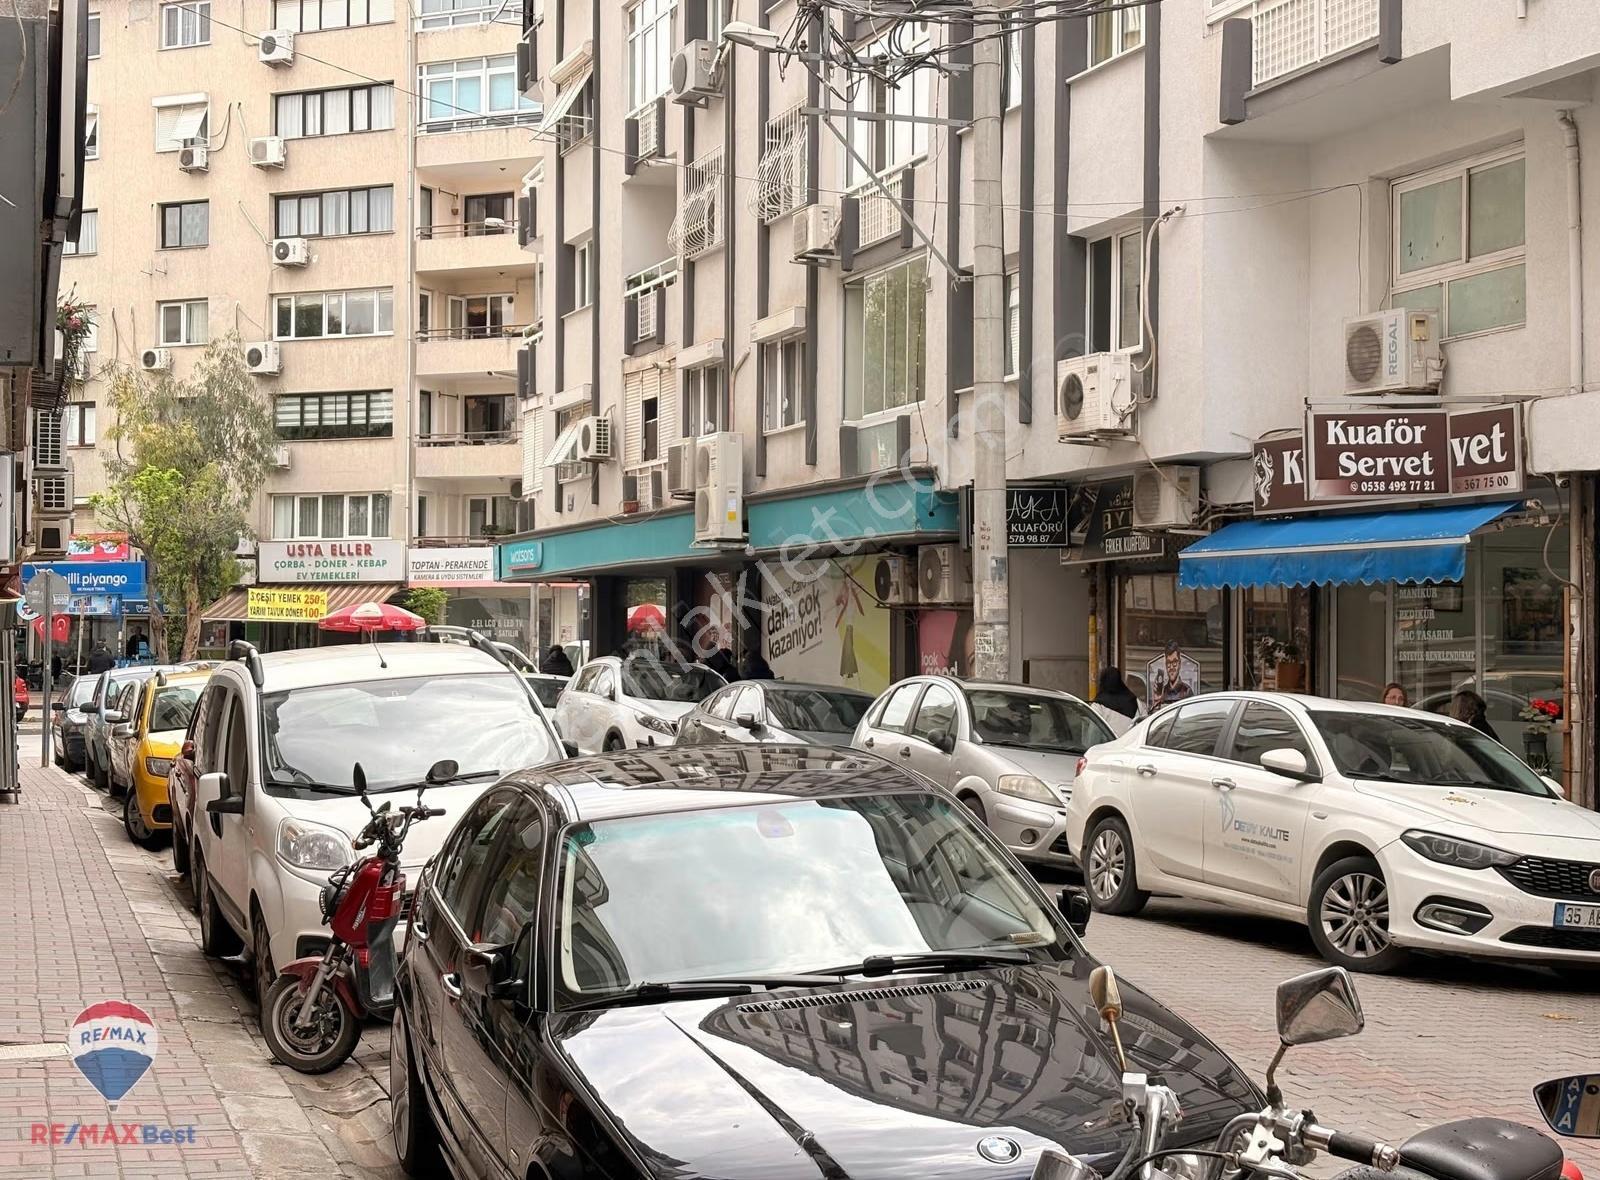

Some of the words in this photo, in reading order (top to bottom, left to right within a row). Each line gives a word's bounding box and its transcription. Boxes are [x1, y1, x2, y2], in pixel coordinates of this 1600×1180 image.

[1388, 317, 1398, 376] REGAL
[1325, 417, 1427, 446] Kuaför
[1338, 450, 1435, 477] Servet
[1361, 481, 1386, 491] 0538
[1389, 481, 1407, 491] 492
[1409, 481, 1420, 491] 77
[1424, 480, 1435, 491] 21
[1483, 476, 1495, 488] 75
[1497, 475, 1509, 487] 00
[1011, 521, 1063, 533] KUAFÖRÜ
[1009, 534, 1025, 543] 578
[1026, 534, 1038, 543] 98
[1039, 534, 1050, 543] 87
[1105, 537, 1123, 554] ERKEK
[287, 544, 324, 557] USTA
[331, 543, 373, 556] ELLER
[274, 560, 305, 571] ÇORBA
[314, 557, 348, 569] DÖNER
[357, 559, 388, 568] KEBAP
[411, 561, 440, 570] TOPTAN
[444, 560, 489, 569] PERAKENDE
[64, 572, 80, 585] illi
[82, 572, 128, 587] piyango
[296, 572, 308, 580] EV
[310, 569, 360, 580] YEMEKLERİ
[250, 592, 255, 601] 3
[256, 591, 276, 604] ÇEŞİT
[278, 593, 302, 603] YEMEK
[304, 594, 320, 605] 250
[250, 606, 267, 616] YARIM
[267, 607, 284, 617] TAVUK
[285, 606, 303, 618] DÖNER
[304, 607, 320, 618] 100
[767, 602, 796, 636] daha
[798, 584, 820, 625] çok
[768, 609, 823, 662] kazanıyor!
[1416, 629, 1454, 641] TASARIM
[920, 651, 939, 667] look
[1565, 907, 1581, 924] 35
